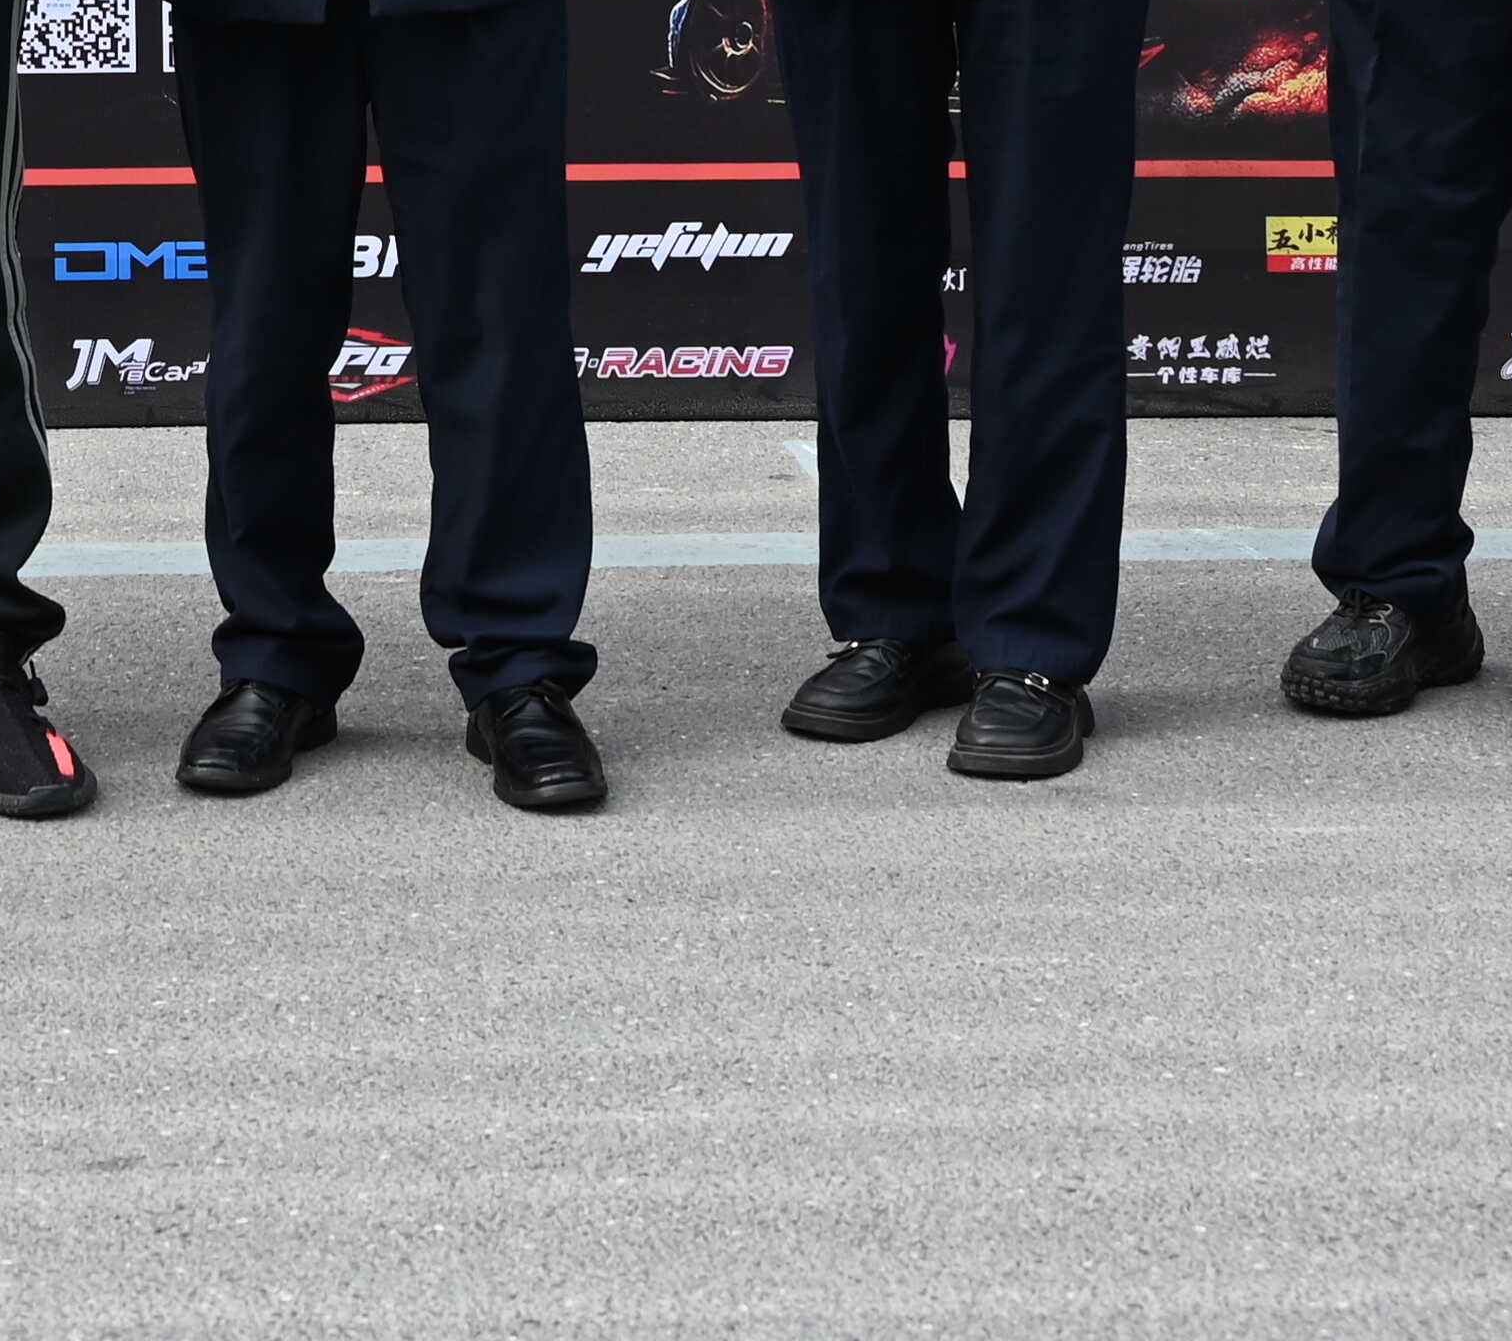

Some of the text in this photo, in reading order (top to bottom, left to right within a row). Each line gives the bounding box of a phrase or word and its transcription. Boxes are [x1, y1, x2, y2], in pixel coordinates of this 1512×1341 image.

[1123, 241, 1174, 251] angTires
[1156, 367, 1242, 385] 个性车库
